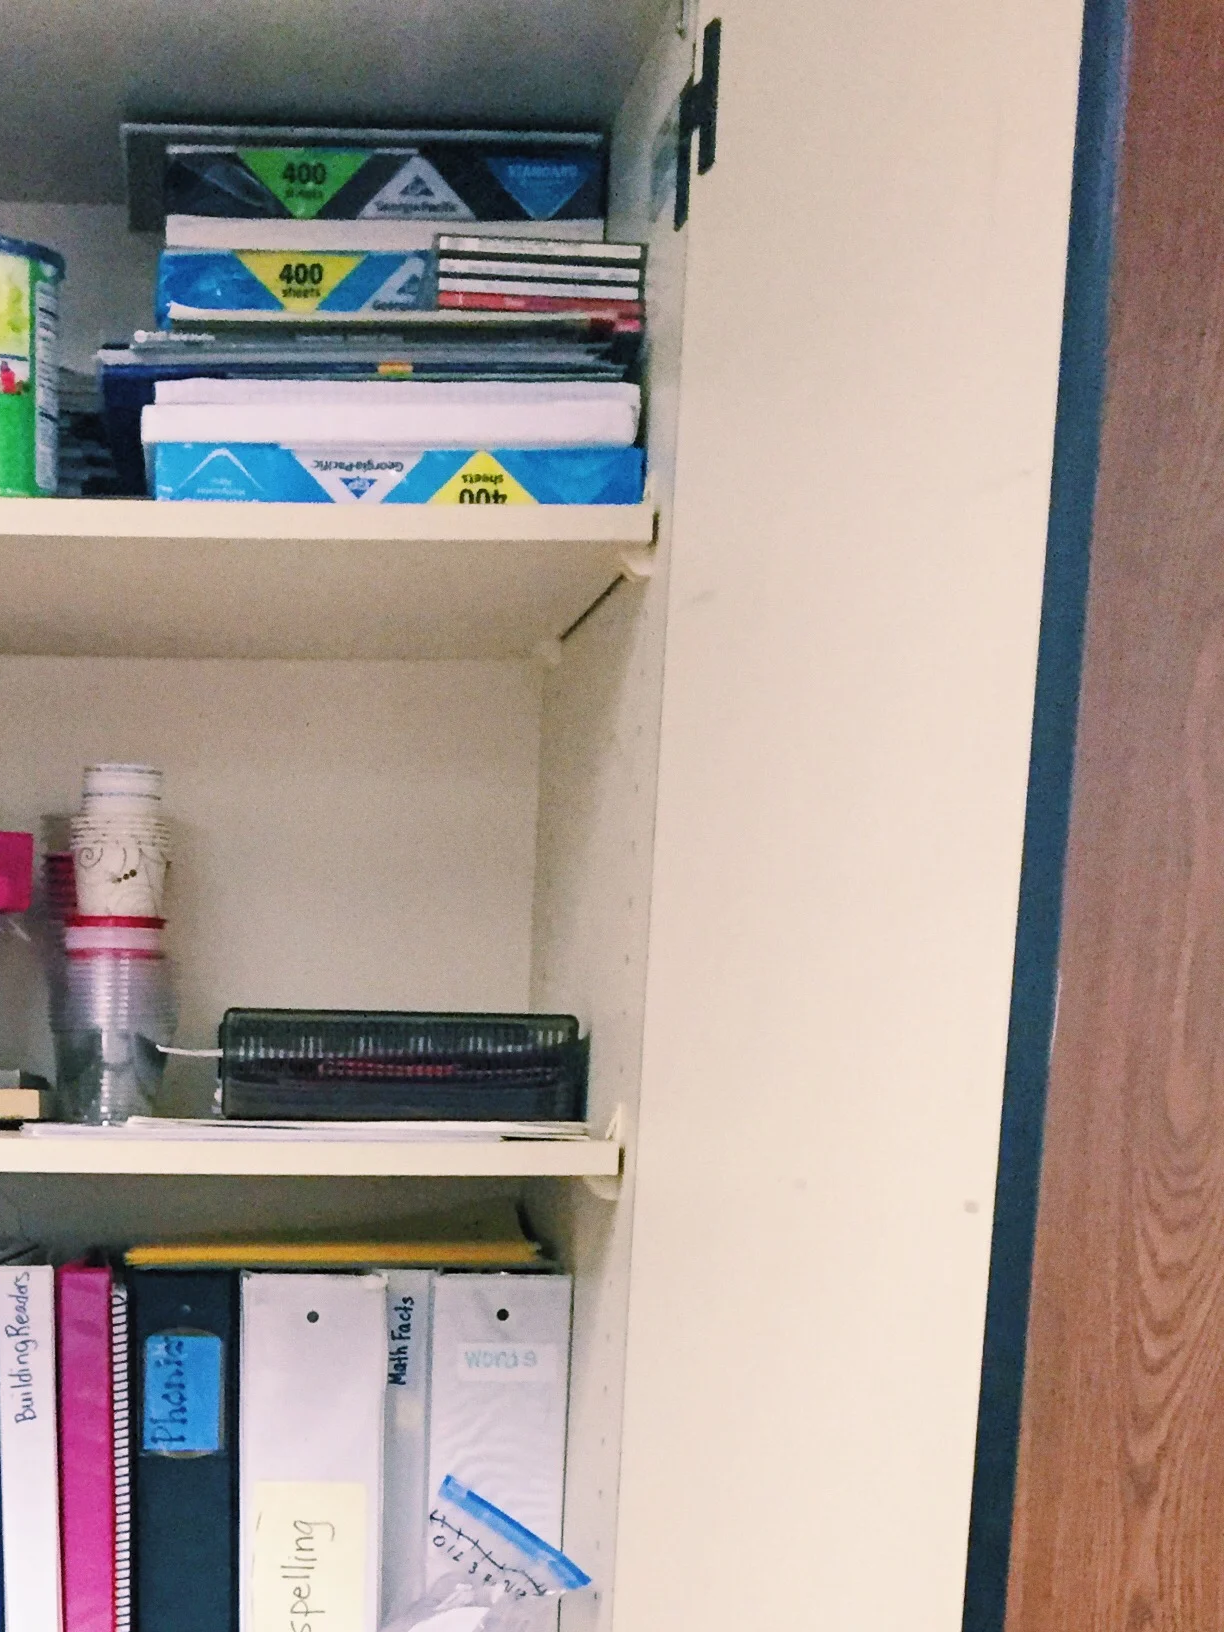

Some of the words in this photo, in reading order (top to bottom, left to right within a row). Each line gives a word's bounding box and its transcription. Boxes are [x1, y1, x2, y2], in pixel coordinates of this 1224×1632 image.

[282, 163, 325, 184] 400
[279, 263, 323, 285] 400
[282, 287, 322, 299] sheets
[313, 459, 404, 474] Georgia-Pacific
[461, 471, 505, 485] sheets
[387, 1344, 408, 1387] Math
[400, 1295, 416, 1342] Facts
